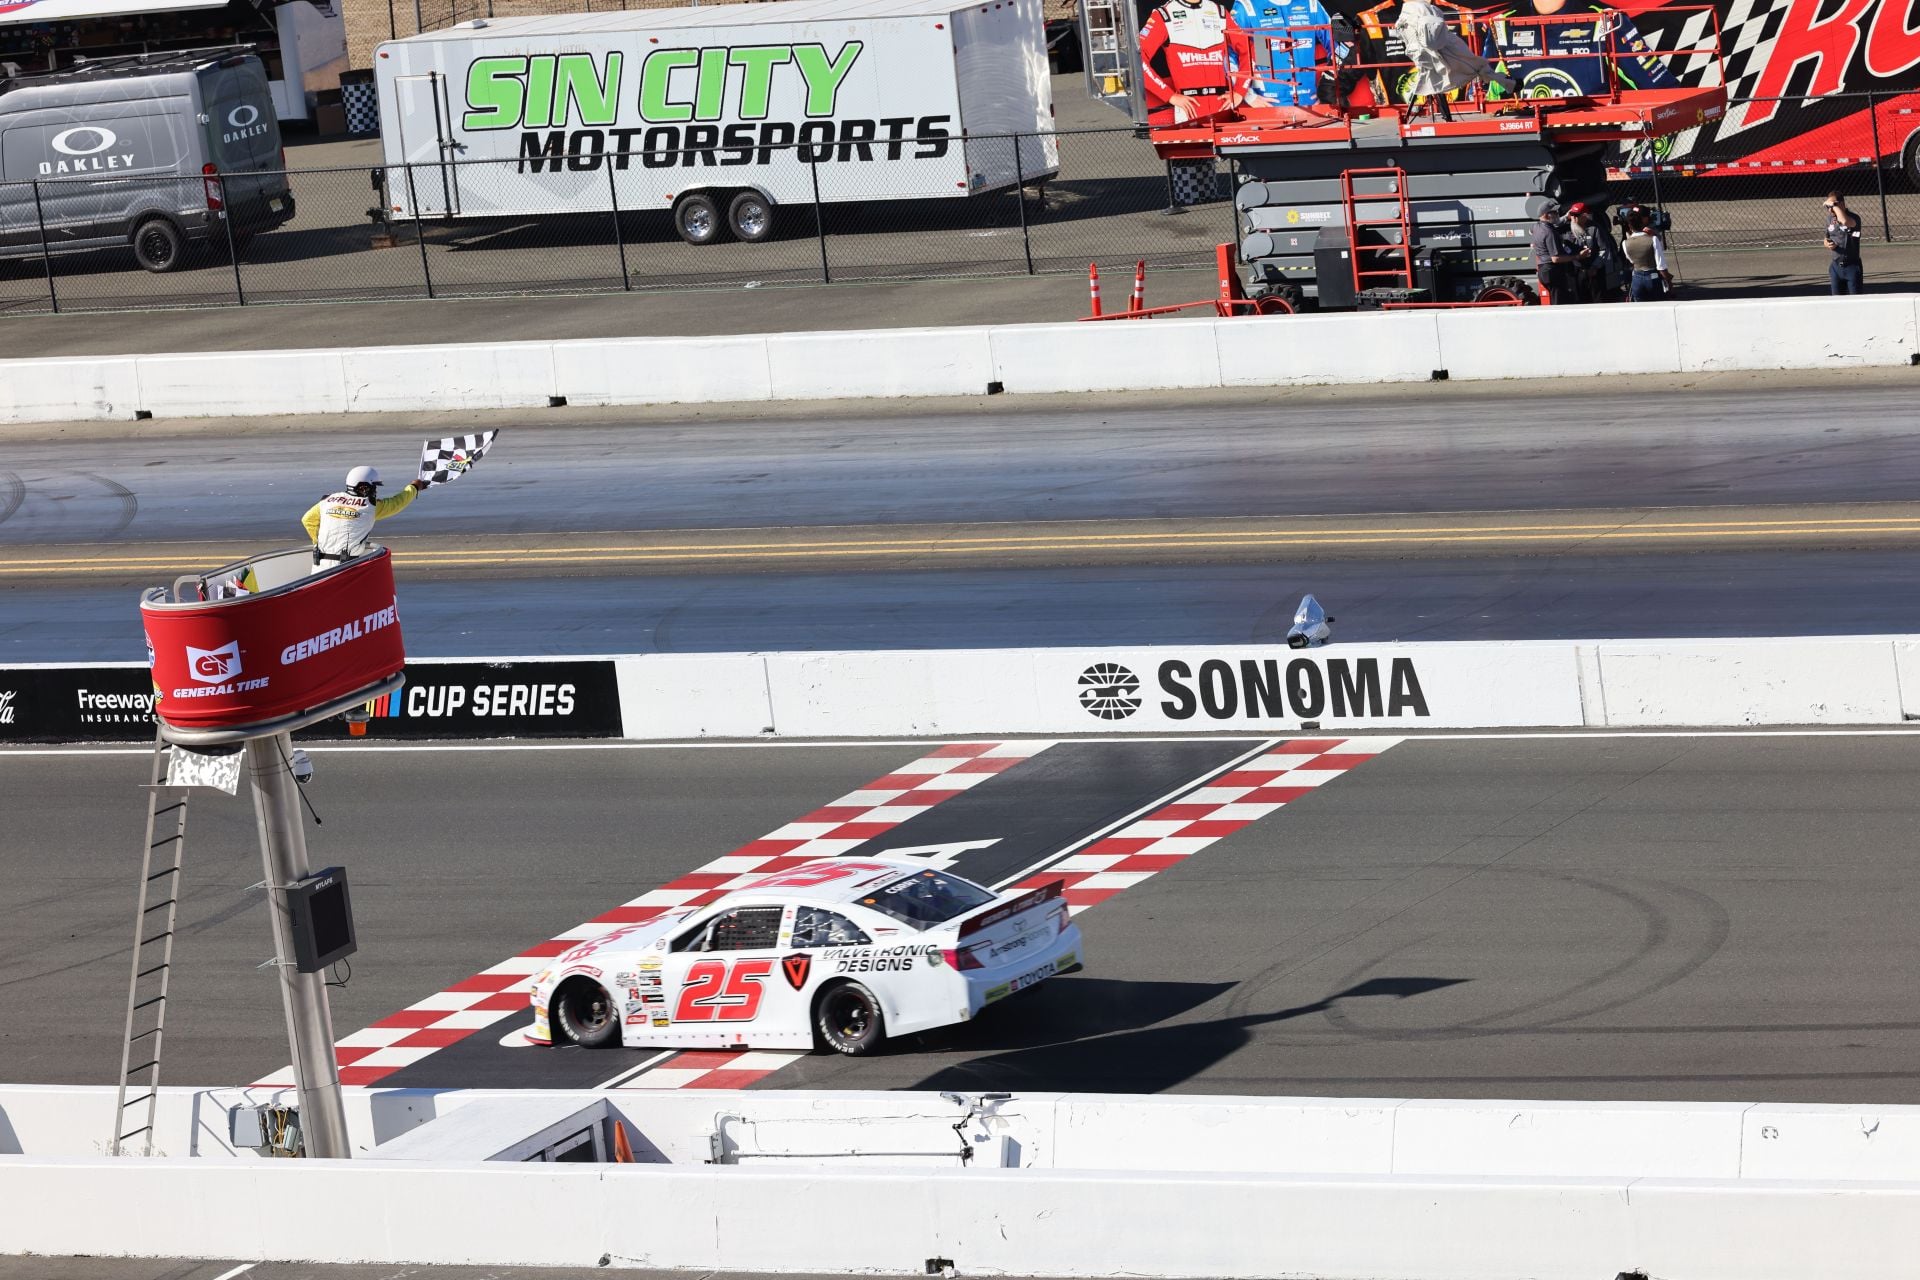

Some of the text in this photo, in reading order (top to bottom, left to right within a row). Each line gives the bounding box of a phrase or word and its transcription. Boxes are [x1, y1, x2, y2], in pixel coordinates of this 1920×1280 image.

[1177, 50, 1223, 63] WHELEN
[462, 40, 864, 132] SIN CITY
[223, 122, 269, 145] OAKLEY
[517, 114, 952, 175] MOTORSPORTS
[39, 153, 135, 176] OAKLEY
[327, 495, 368, 507] OFFICIAL
[280, 604, 395, 666] GENERAL TIRE
[77, 688, 155, 712] Freeway
[173, 682, 235, 699] GENERAL
[237, 676, 270, 692] TIRE
[1157, 657, 1431, 720] SONOMA
[407, 684, 577, 718] CUP SERIES
[836, 957, 913, 973] DESIGNS
[1019, 962, 1056, 988] TOYOTA
[671, 957, 781, 1023] 25
